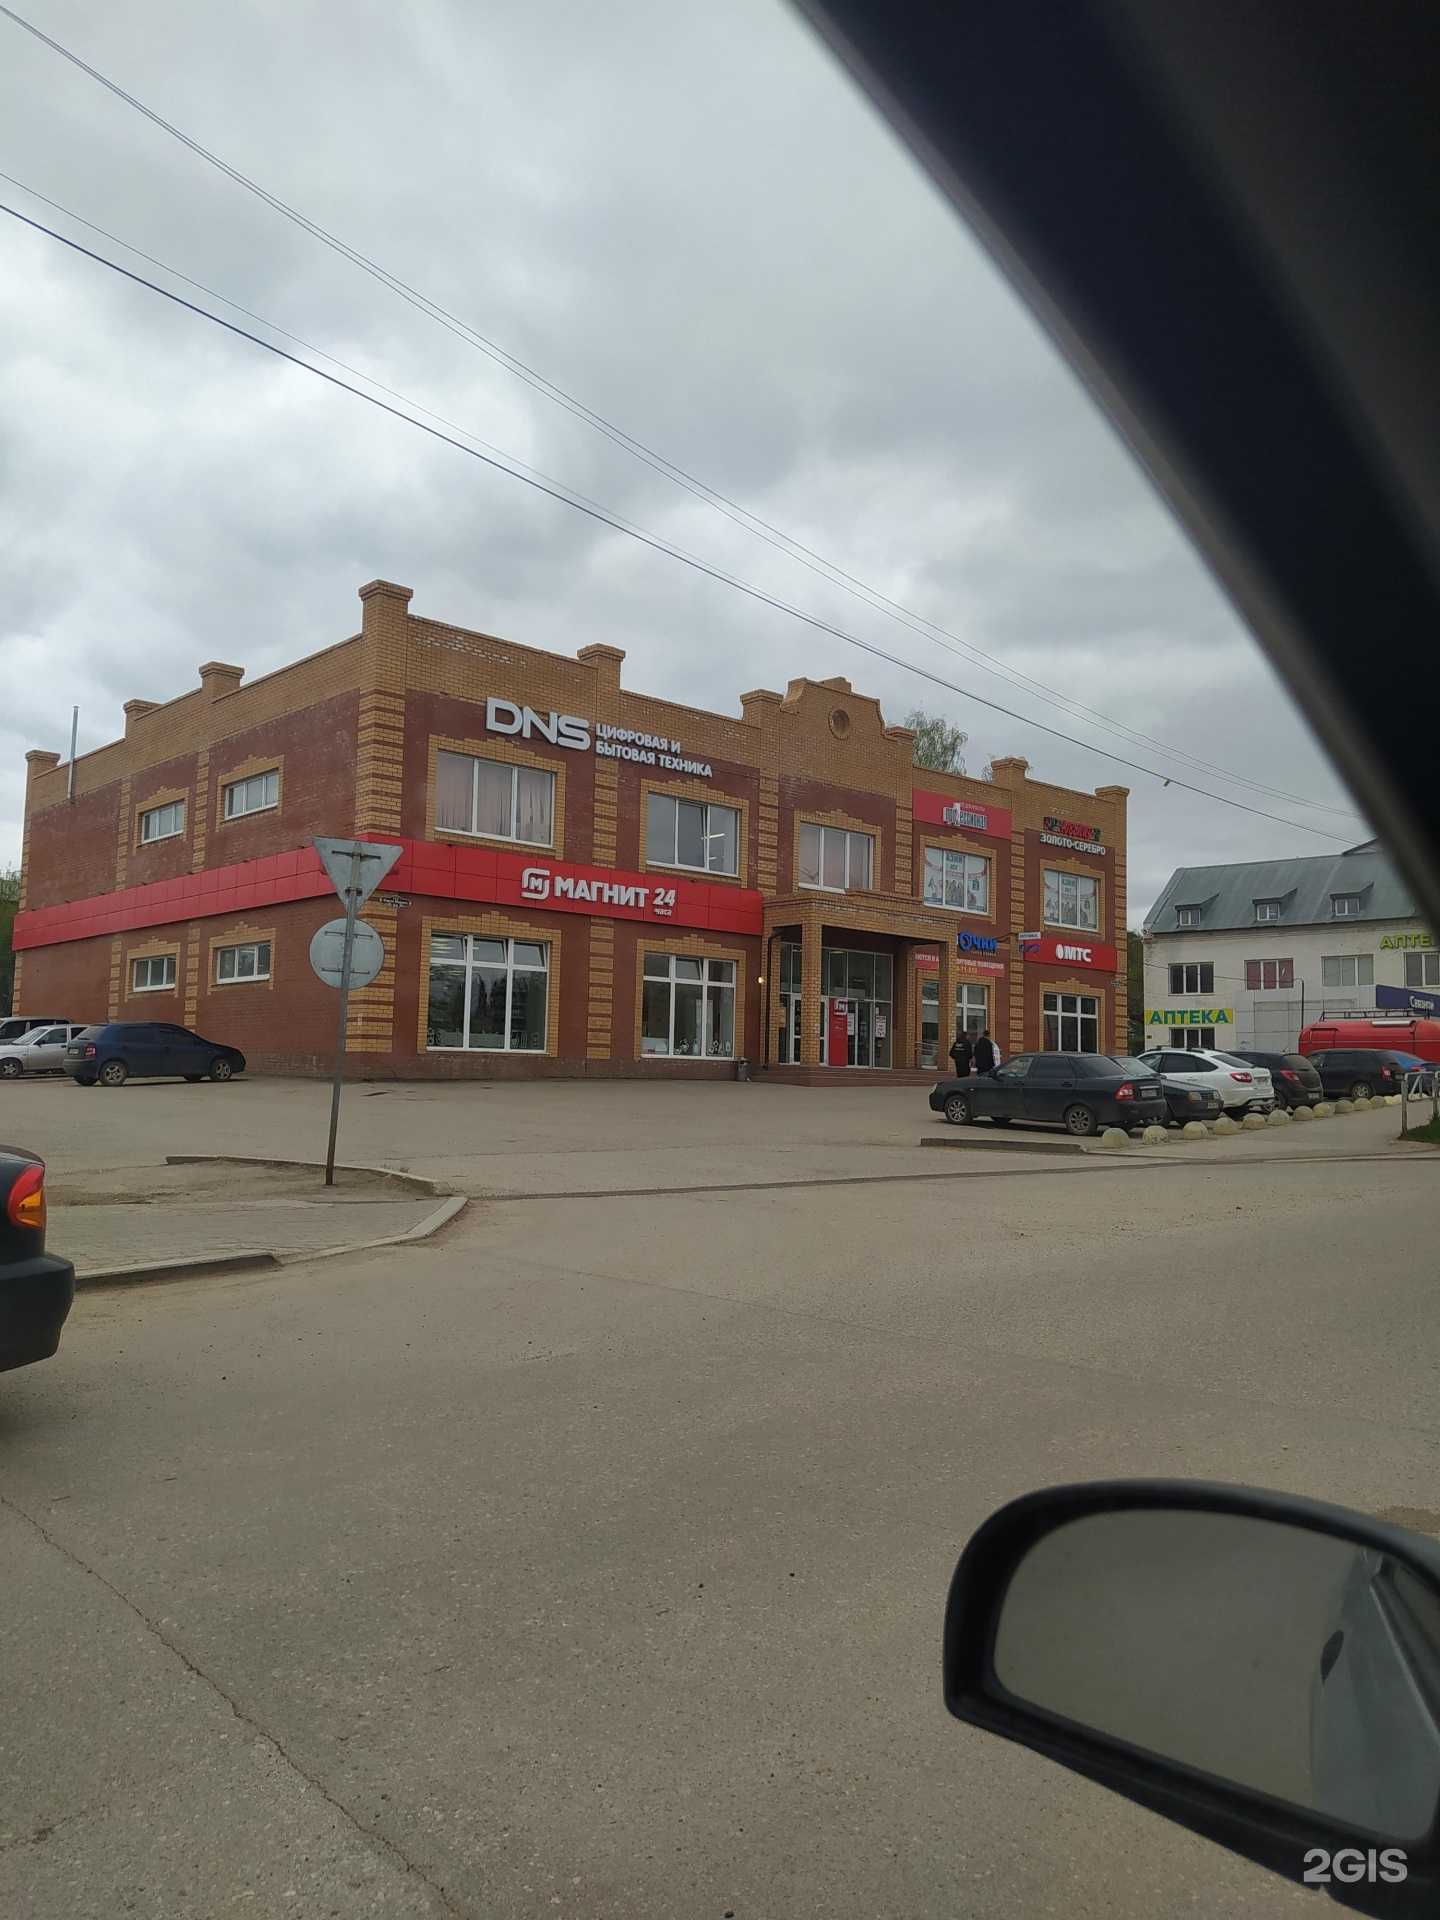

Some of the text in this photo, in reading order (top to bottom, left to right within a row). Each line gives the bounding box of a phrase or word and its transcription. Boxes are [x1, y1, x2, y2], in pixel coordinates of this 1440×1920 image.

[486, 697, 591, 751] DNS
[595, 723, 681, 754] ЦИФРОВАЯ И
[595, 740, 713, 778] БЫТОВАЯ ТЕХНИКА
[1040, 833, 1106, 855] ЗОЛОТО-СЕРЕБРО
[554, 876, 676, 907] МАГНИТ 24
[1064, 946, 1092, 962] МТС
[1379, 933, 1434, 949] АПТЕ
[1149, 1008, 1229, 1025] АПТЕКА
